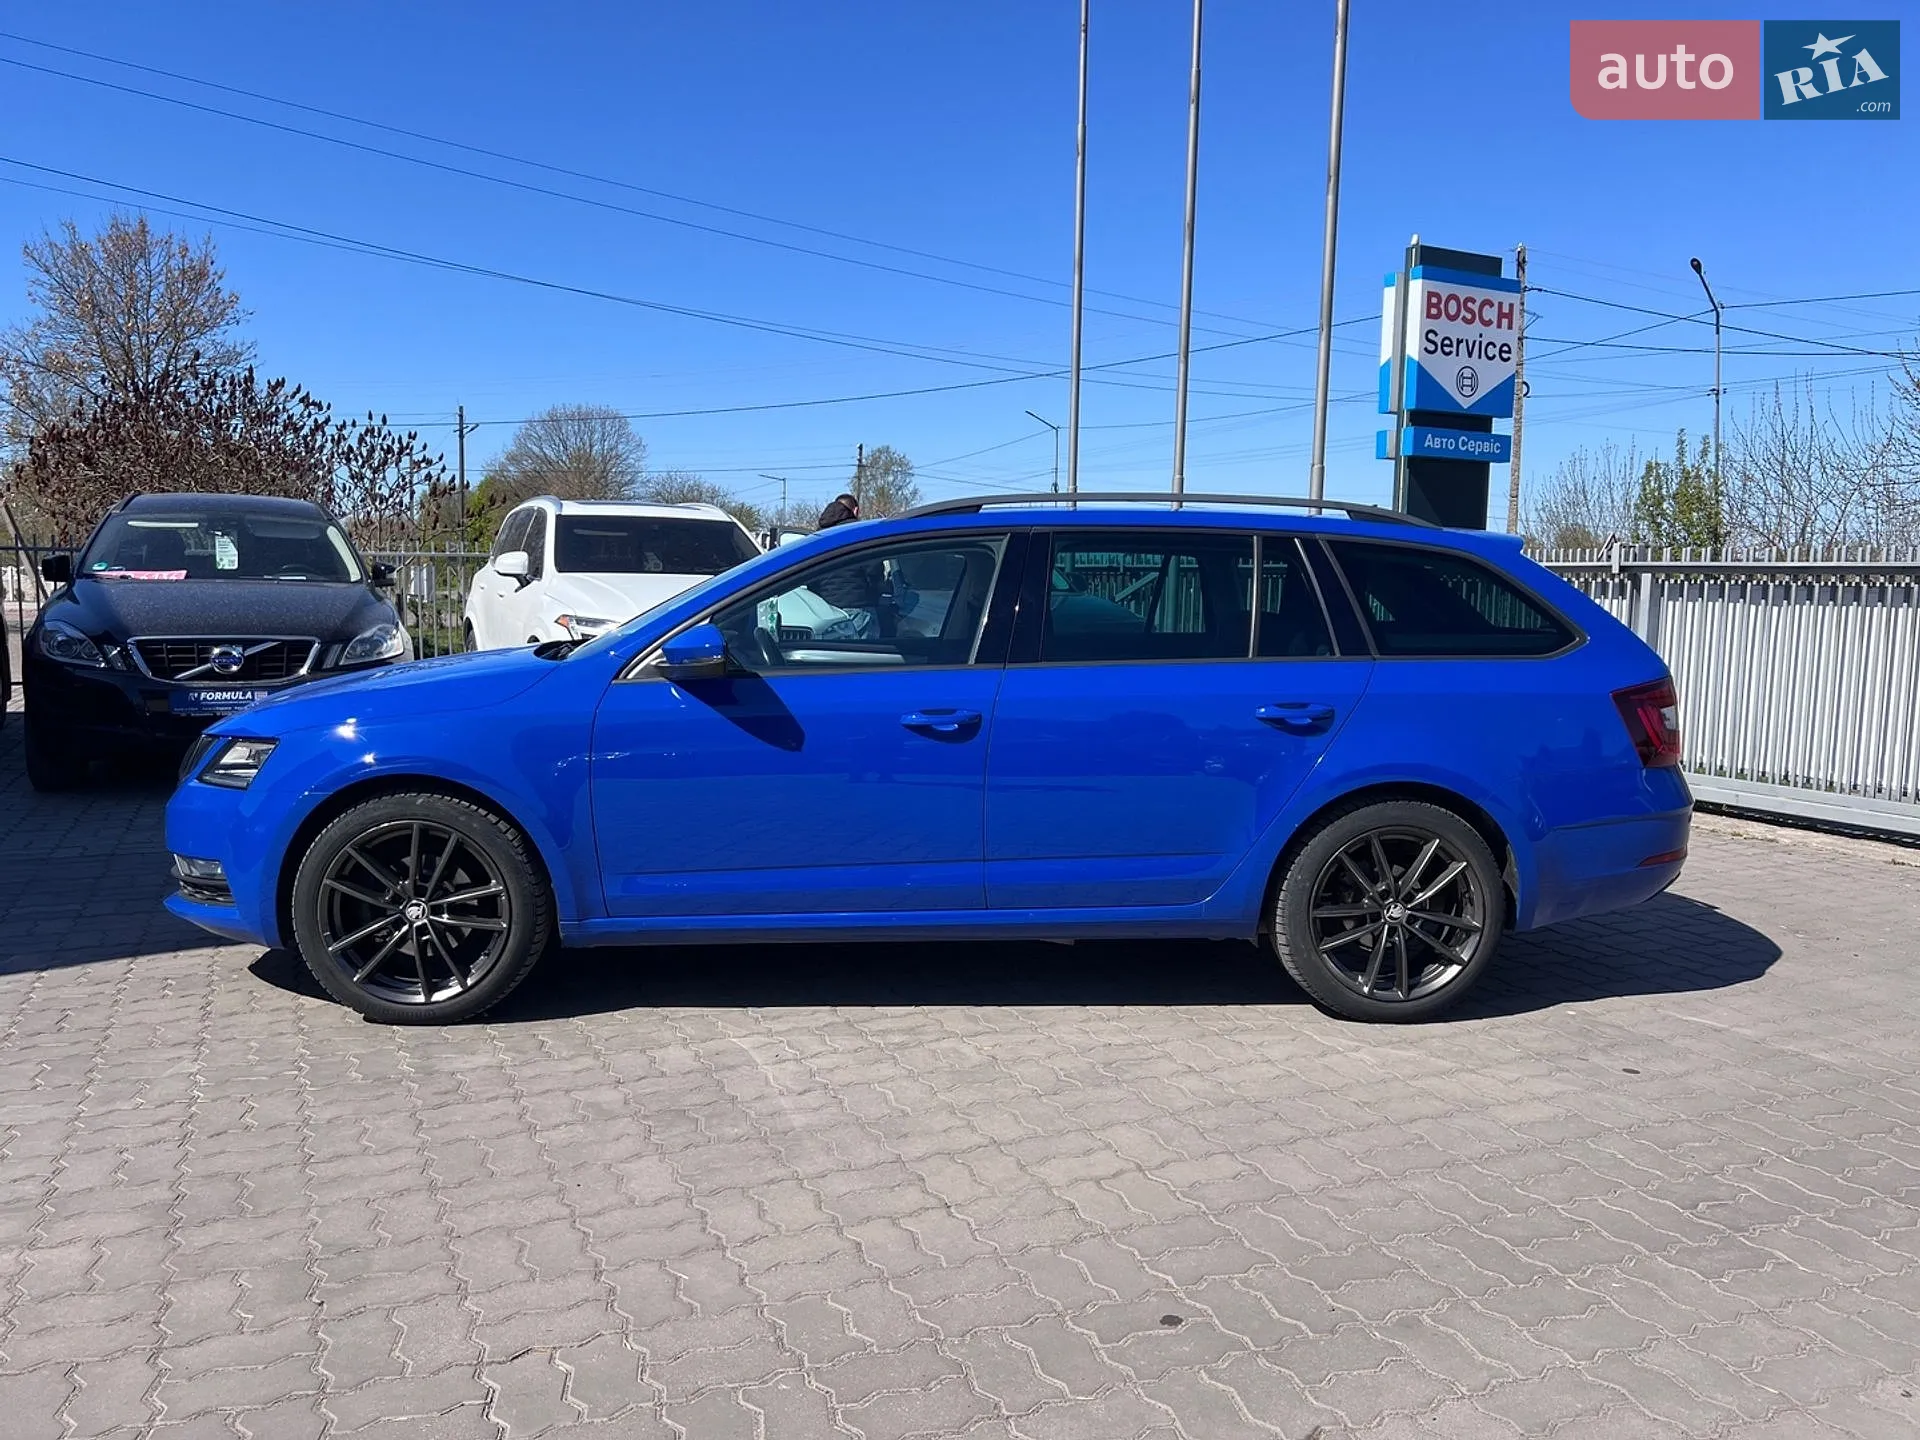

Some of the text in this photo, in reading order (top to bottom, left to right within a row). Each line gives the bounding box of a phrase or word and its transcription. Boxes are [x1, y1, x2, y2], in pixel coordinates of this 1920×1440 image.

[1425, 291, 1515, 330] BOSCH
[1424, 328, 1512, 363] Service
[1424, 433, 1501, 457] Авто Сервіс
[200, 691, 252, 701] FORMULA
